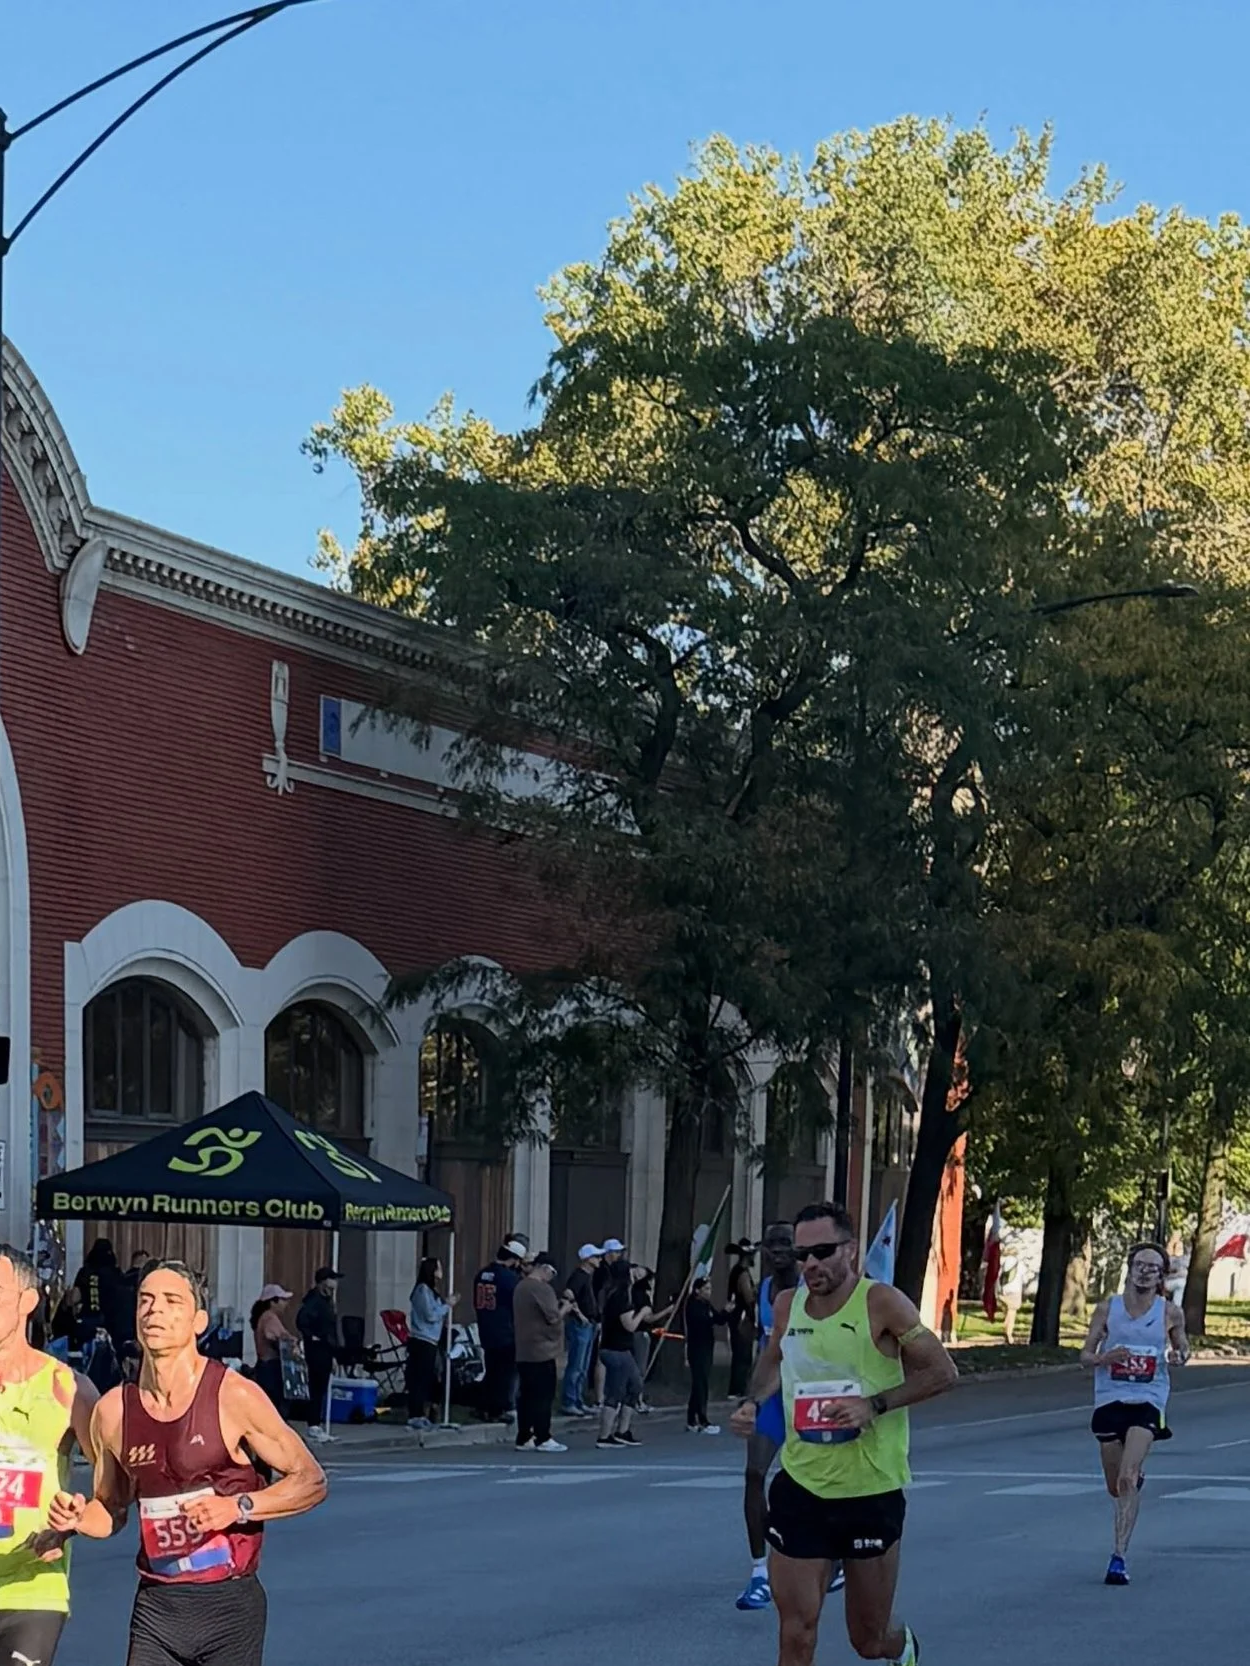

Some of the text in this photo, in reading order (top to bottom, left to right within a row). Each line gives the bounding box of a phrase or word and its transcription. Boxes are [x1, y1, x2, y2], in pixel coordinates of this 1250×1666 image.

[52, 1191, 325, 1221] Berwyn Runners Club
